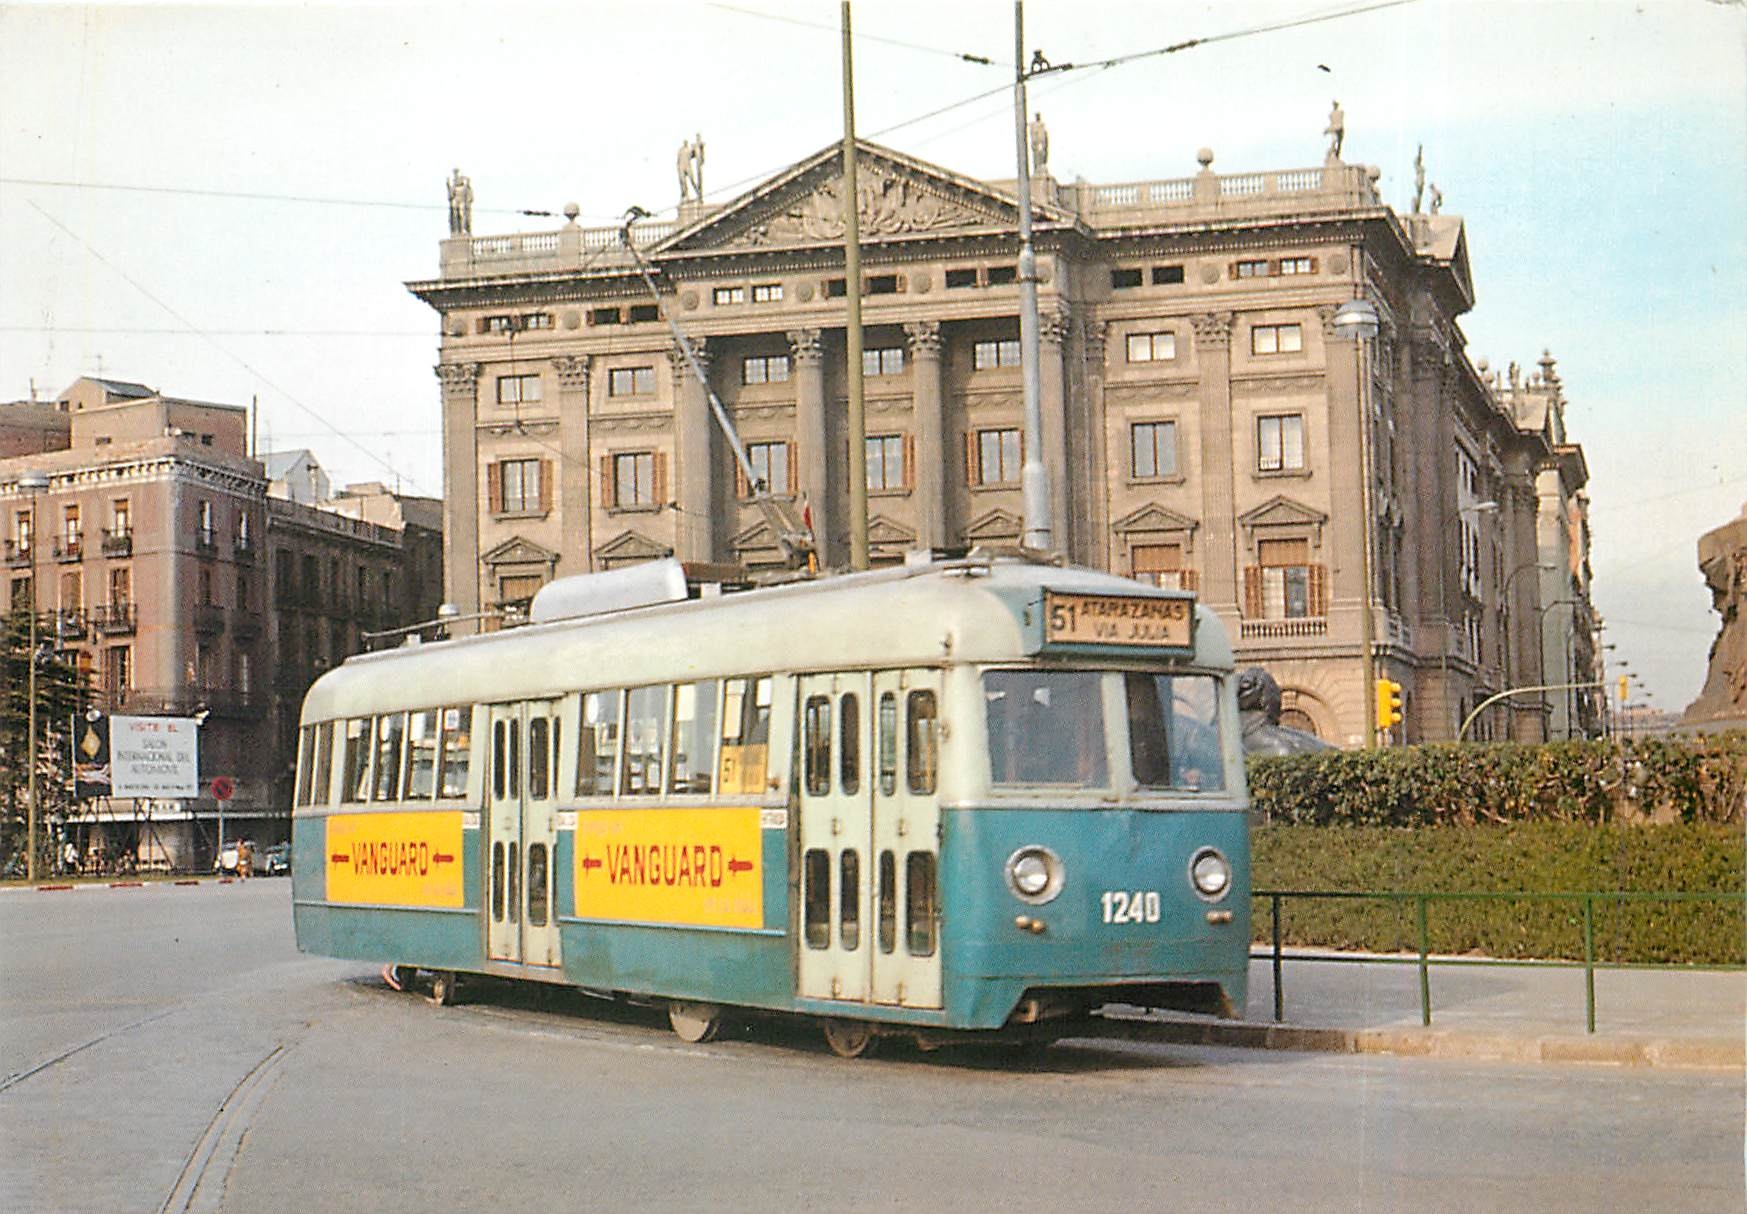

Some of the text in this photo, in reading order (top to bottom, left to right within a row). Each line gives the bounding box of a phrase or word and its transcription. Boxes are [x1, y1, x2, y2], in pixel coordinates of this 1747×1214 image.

[1051, 600, 1185, 633] 51 ATARAZANAS
[1094, 622, 1170, 640] VIA JULIA
[352, 841, 429, 876] VANGUARD
[606, 843, 723, 888] VANGUARD
[1101, 891, 1161, 924] 1240
